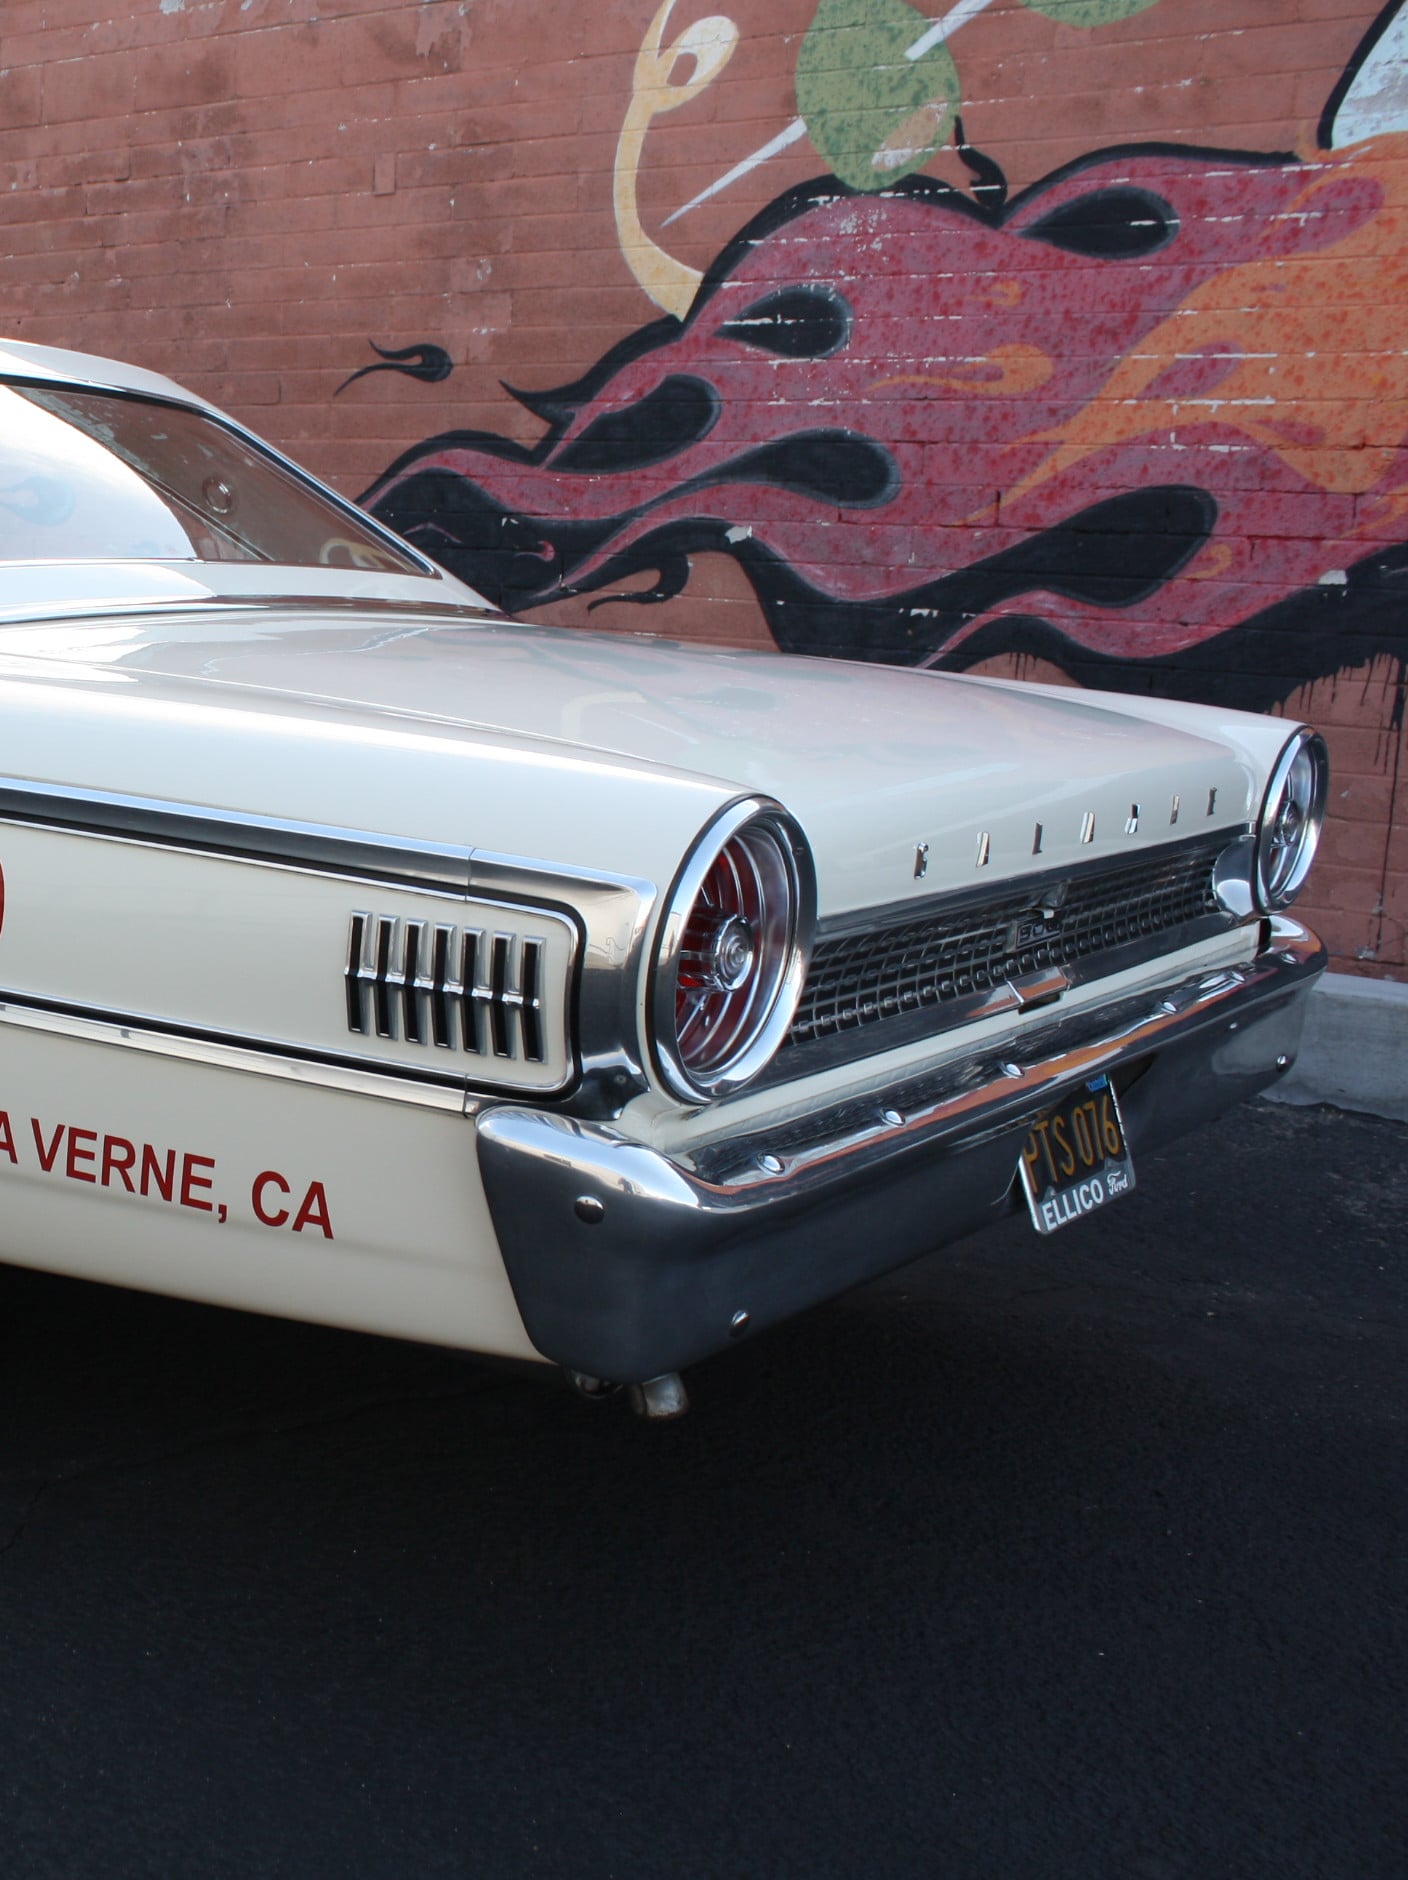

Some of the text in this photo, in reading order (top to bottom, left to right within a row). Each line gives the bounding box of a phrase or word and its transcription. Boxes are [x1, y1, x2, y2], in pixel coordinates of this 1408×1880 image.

[30, 1117, 229, 1224] VERNE,
[251, 1171, 335, 1241] CA
[1022, 1093, 1120, 1194] PTS 076
[1042, 1170, 1129, 1231] ELLICO Ford
